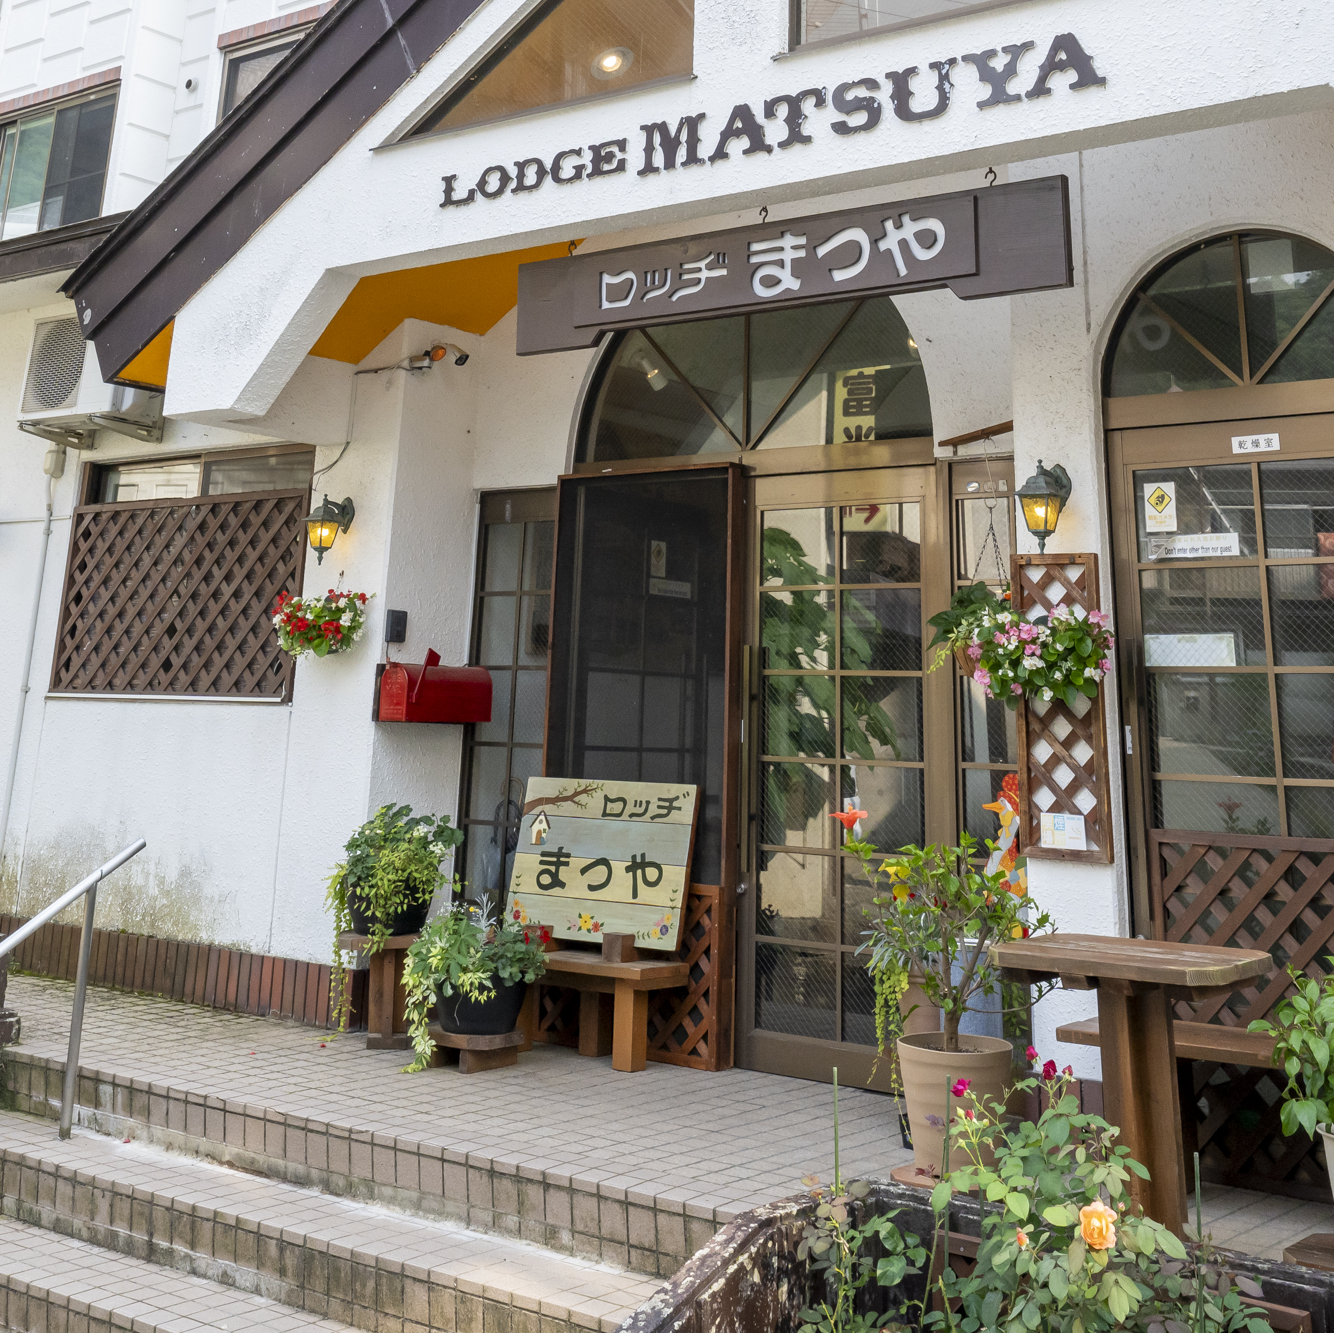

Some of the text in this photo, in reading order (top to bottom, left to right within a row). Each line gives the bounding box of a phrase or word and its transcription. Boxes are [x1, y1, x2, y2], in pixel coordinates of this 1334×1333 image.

[439, 32, 1106, 210] LODGE MATSUYA
[598, 211, 946, 310] ロッヂ まつや
[1237, 437, 1274, 450] 乾燥室
[1164, 547, 1177, 555] Don't
[1177, 547, 1188, 555] enter
[1189, 545, 1200, 554] other
[1201, 545, 1210, 554] than
[1219, 545, 1233, 555] guest
[600, 791, 691, 823] ロッヂ
[535, 845, 664, 901] まつや
